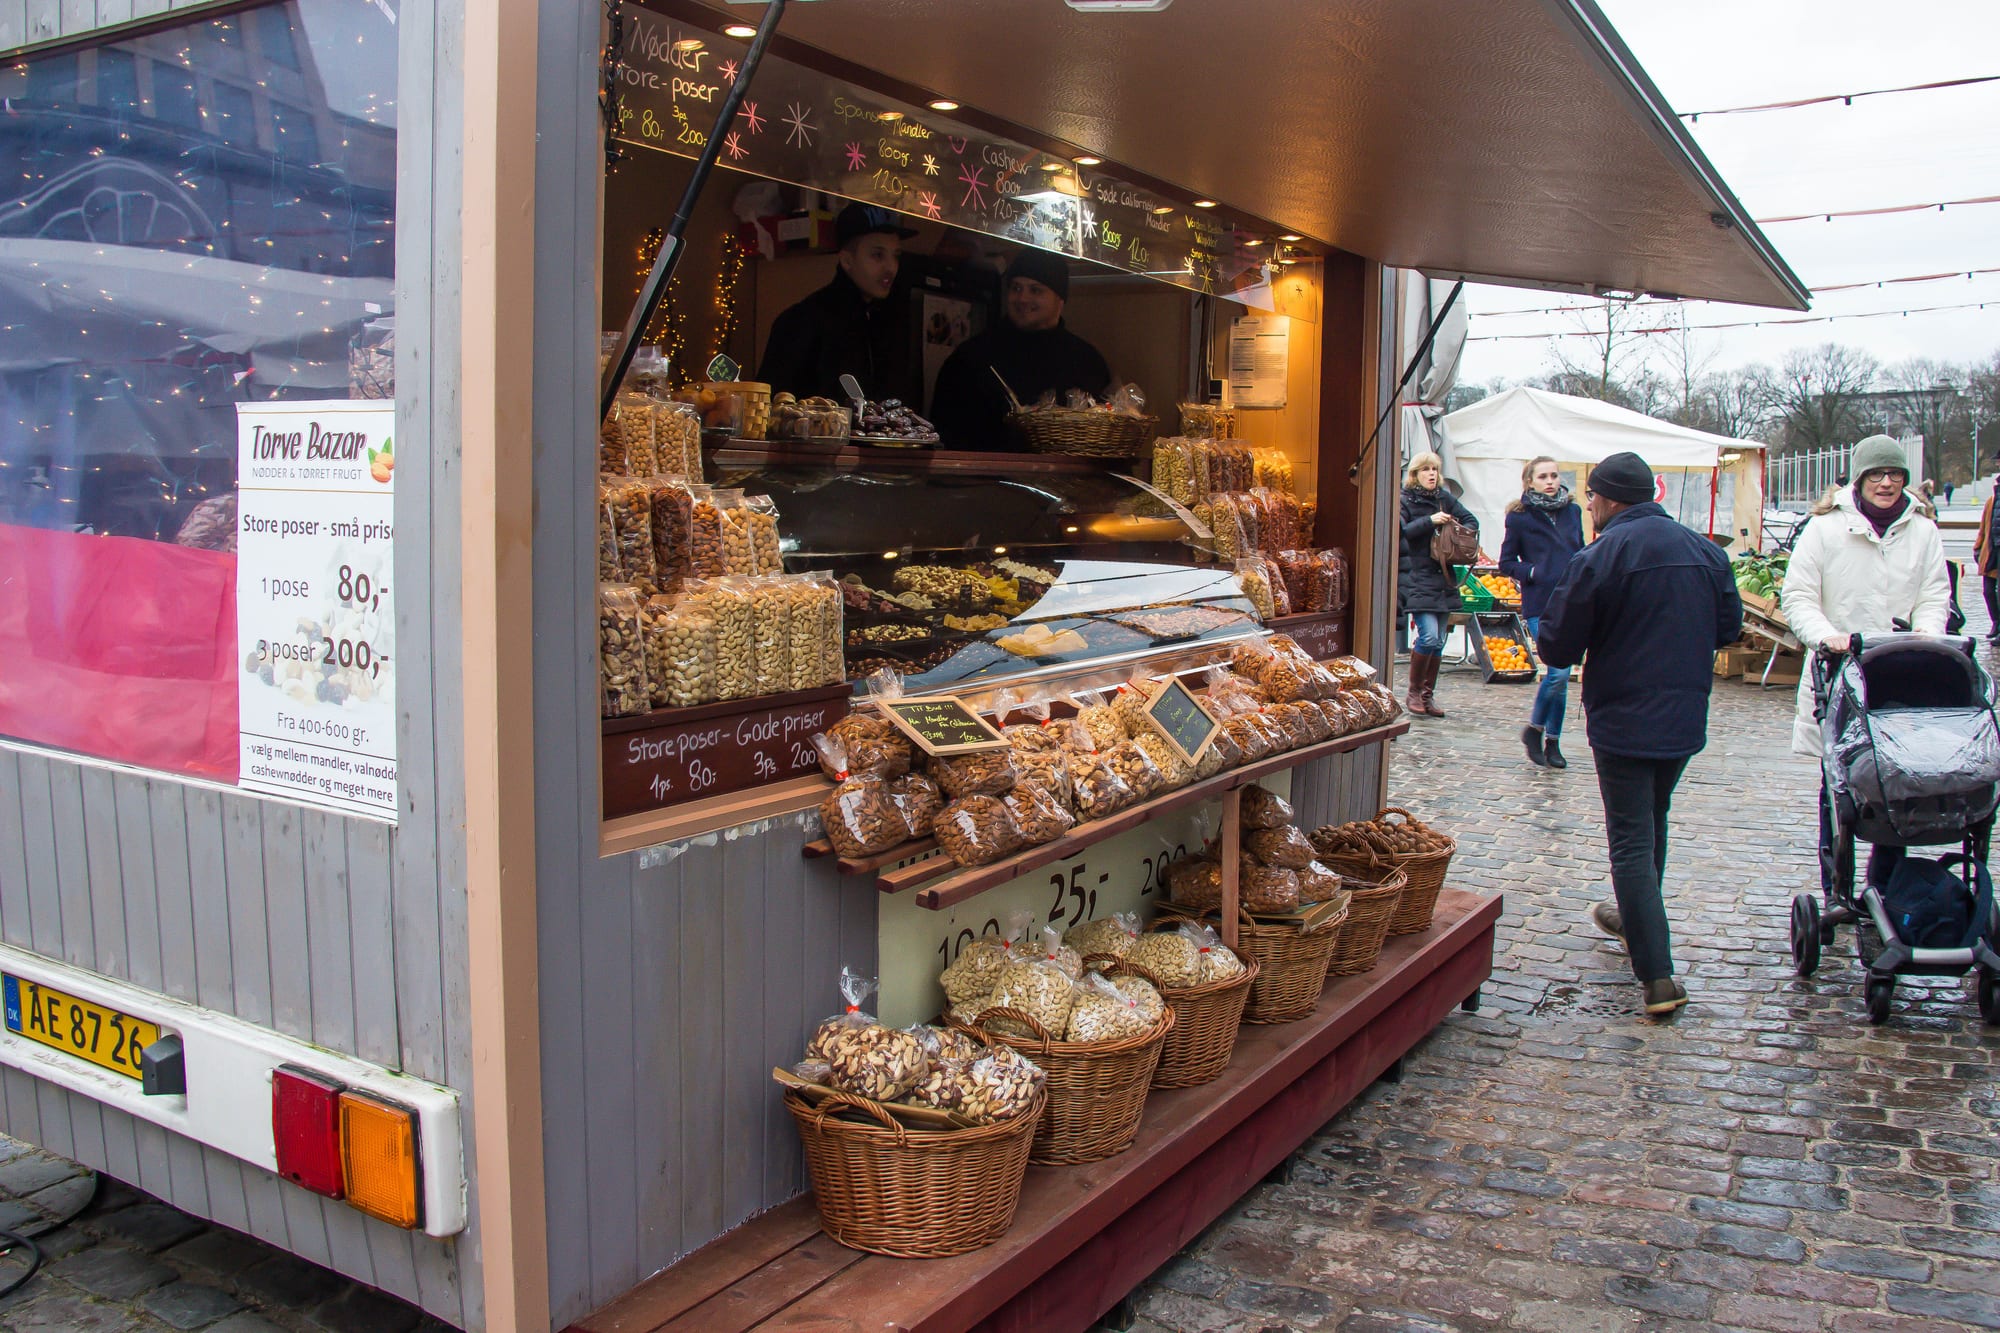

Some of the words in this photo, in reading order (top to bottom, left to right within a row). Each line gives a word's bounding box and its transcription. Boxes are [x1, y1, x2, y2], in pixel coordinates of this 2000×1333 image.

[630, 21, 709, 72] Nødder
[617, 60, 667, 89] tore-
[672, 77, 719, 102] poser
[252, 425, 302, 461] Torve
[306, 422, 366, 461] Bazar
[252, 467, 288, 479] NØDDER
[290, 468, 295, 479] &
[298, 468, 330, 480] TØRRET
[333, 469, 363, 480] FRUGT
[243, 514, 278, 533] Store
[281, 520, 319, 539] poser
[331, 517, 359, 538] små
[262, 577, 267, 594] 1
[272, 578, 309, 601] pose
[338, 564, 389, 613] 80,-
[259, 639, 267, 661] 3
[272, 642, 316, 664] poser
[323, 636, 389, 680] 200,-
[277, 712, 295, 730] Fra
[298, 718, 349, 739] 400-600
[352, 727, 369, 747] gr.
[628, 737, 675, 764] Store
[736, 713, 780, 746] Gode
[782, 710, 825, 743] priser
[251, 744, 273, 761] vælg
[275, 747, 308, 763] mellem
[311, 756, 352, 775] mandler,
[251, 763, 317, 786] cashewnødder
[319, 778, 332, 793] og
[334, 781, 365, 798] meget
[367, 787, 393, 802] mere
[1048, 863, 1109, 927] 25,-
[7, 1007, 19, 1022] DK
[30, 986, 63, 1041] AE
[70, 1004, 101, 1053] 87
[110, 1015, 143, 1071] 26
